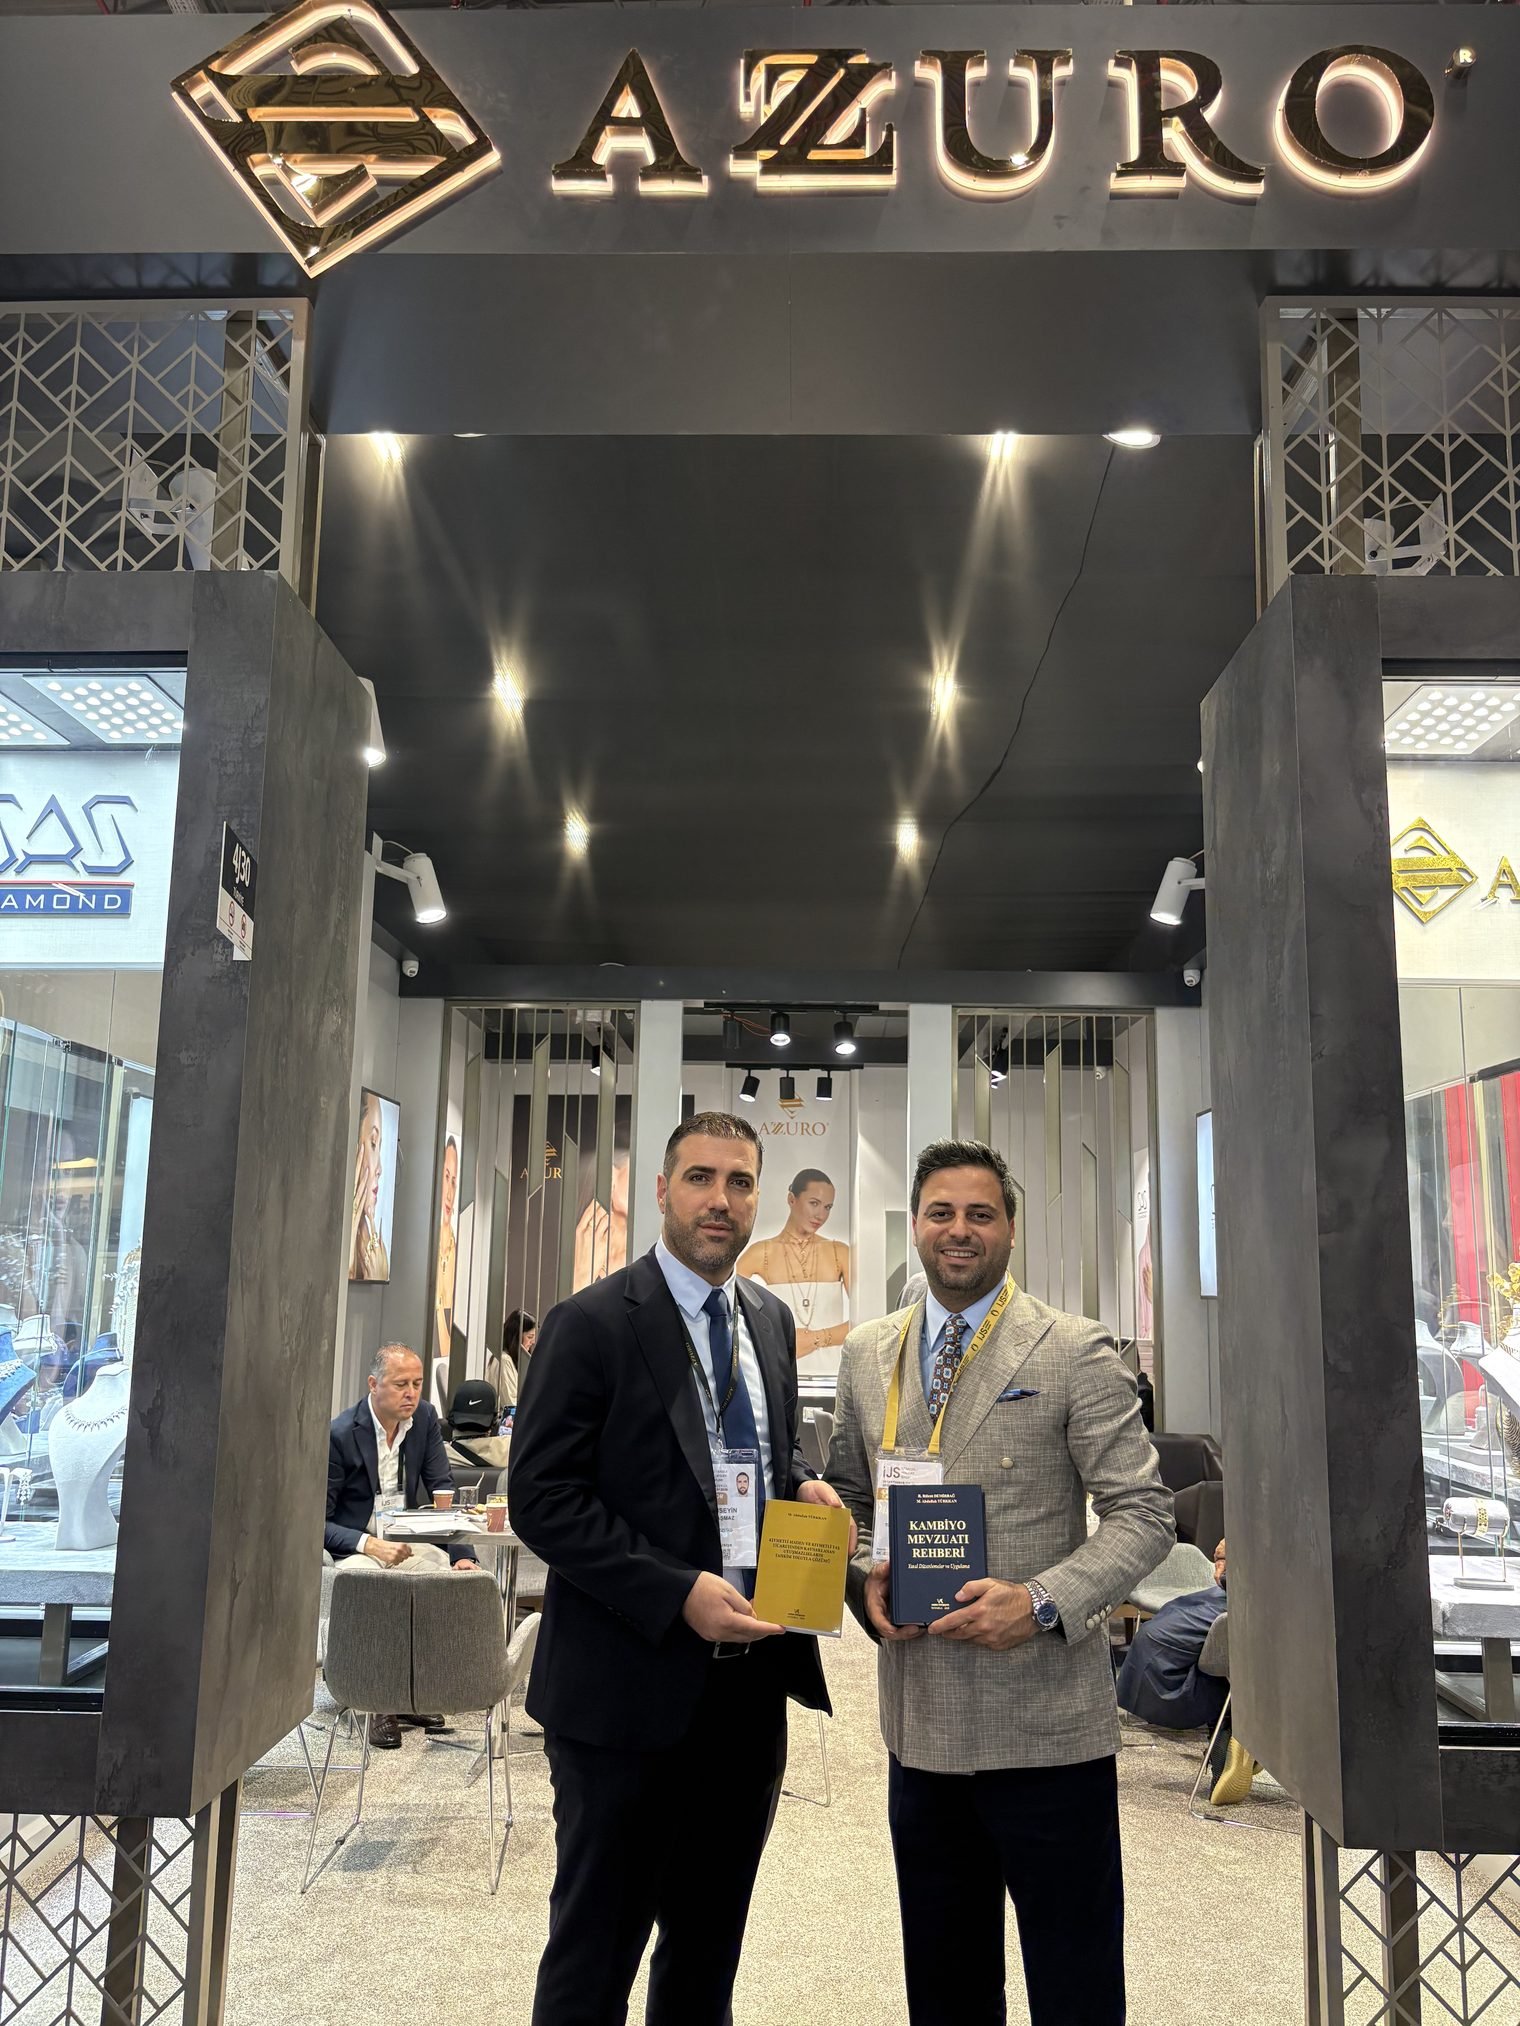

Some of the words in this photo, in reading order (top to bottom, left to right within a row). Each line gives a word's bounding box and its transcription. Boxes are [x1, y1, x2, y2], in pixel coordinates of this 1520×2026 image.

[232, 842, 251, 888] 4J30
[909, 1518, 967, 1531] KAMBİYO
[907, 1534, 970, 1545] MEVZUATI
[912, 1546, 966, 1558] REHBERİ
